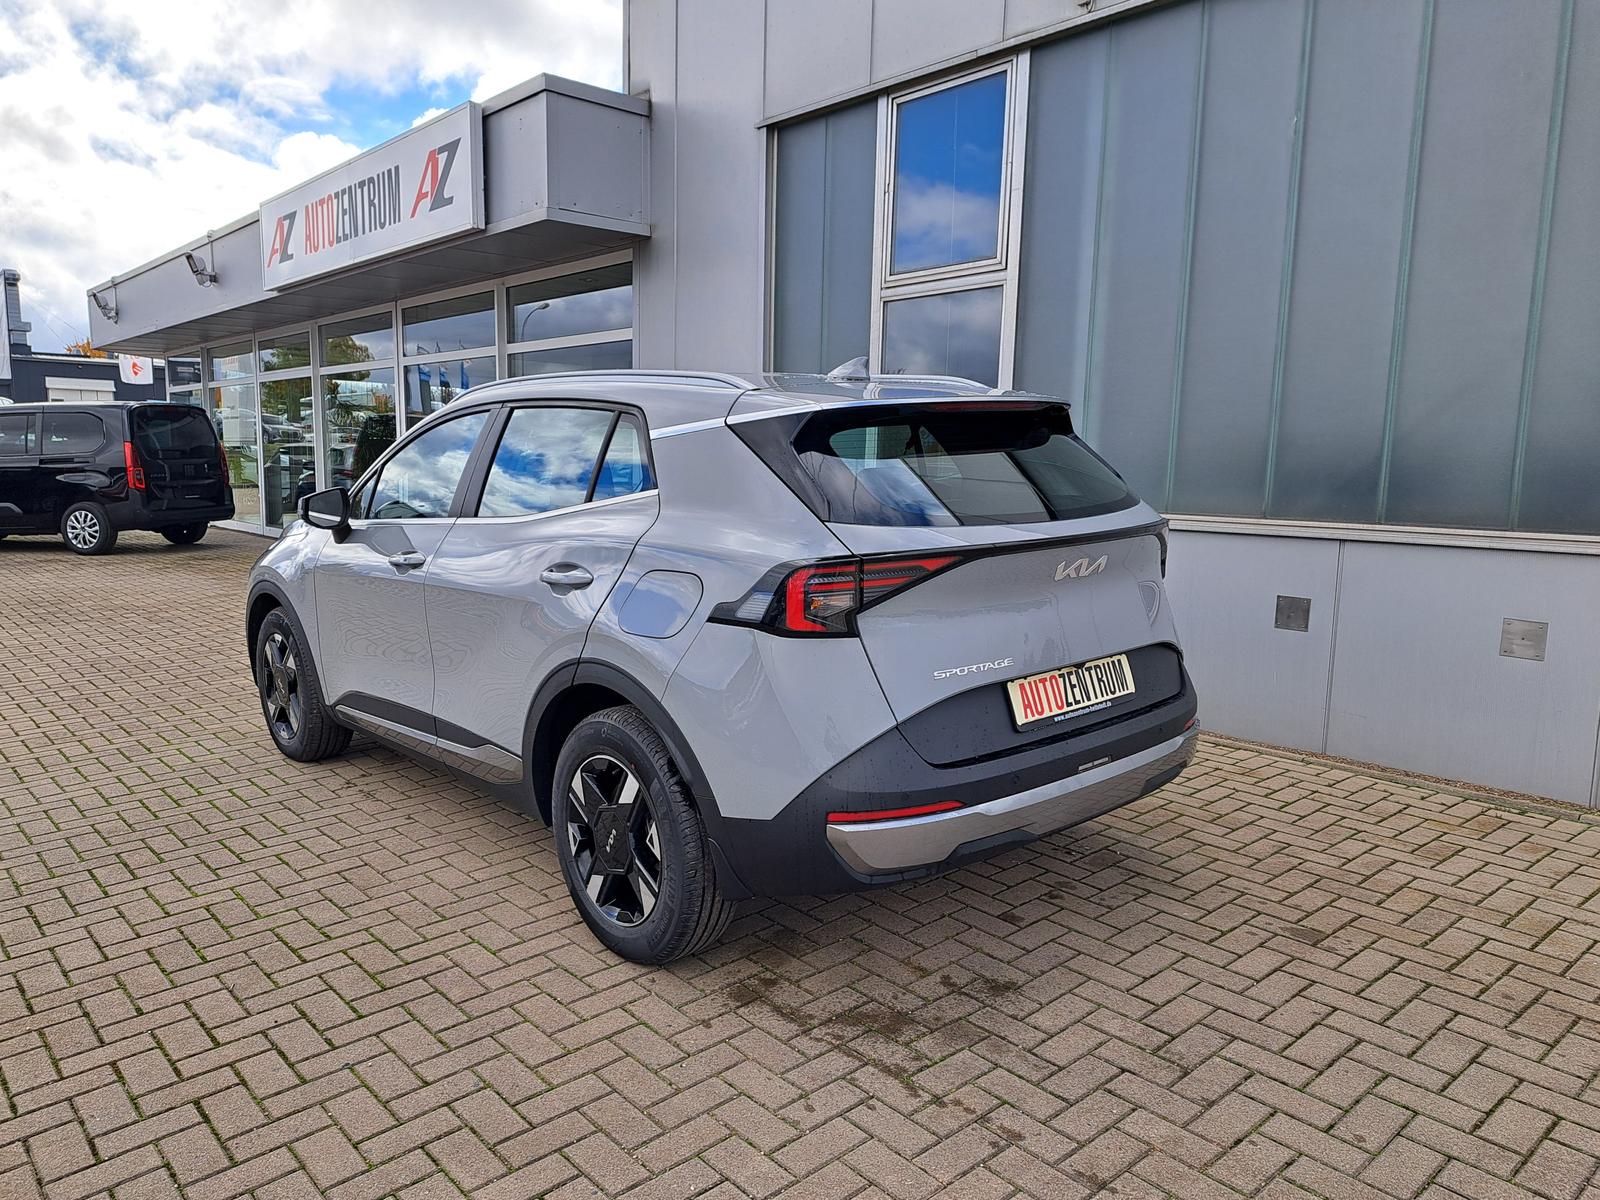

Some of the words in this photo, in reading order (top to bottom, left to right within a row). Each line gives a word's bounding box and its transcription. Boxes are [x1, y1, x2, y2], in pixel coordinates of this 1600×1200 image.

[267, 209, 298, 269] AZ
[304, 164, 401, 256] AUTOZENTRUM
[409, 137, 462, 219] AZ
[1054, 554, 1109, 581] KIA
[933, 657, 1015, 680] SPORTAGE
[1018, 658, 1129, 720] AUTOZENTRUM
